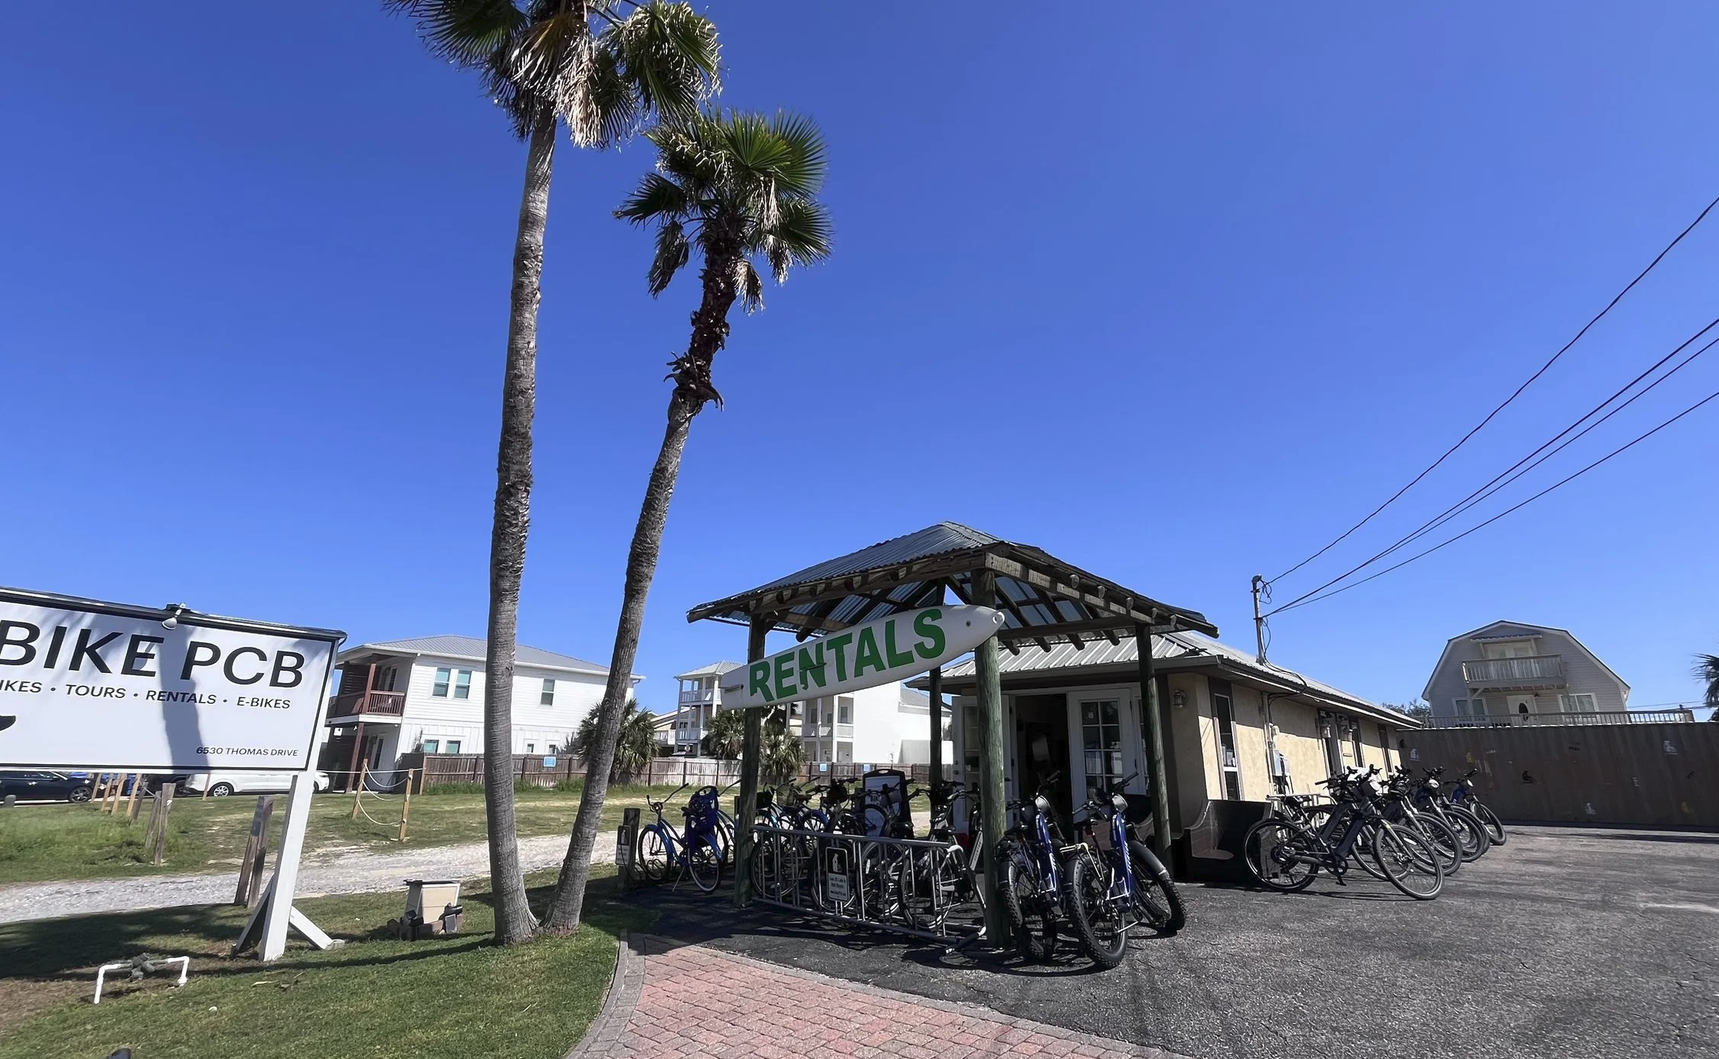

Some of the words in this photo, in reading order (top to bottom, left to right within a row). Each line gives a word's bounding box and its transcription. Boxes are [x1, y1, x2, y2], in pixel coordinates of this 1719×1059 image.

[0, 619, 165, 678] BIKE
[180, 640, 305, 689] PCB
[750, 608, 946, 702] RENTALS
[65, 683, 127, 700] TOURS
[145, 689, 217, 706] RENTALS
[236, 696, 291, 710] E-BIKES
[196, 746, 224, 755] 6530
[225, 747, 269, 756] THOMAS
[270, 748, 299, 757] DRIVE
